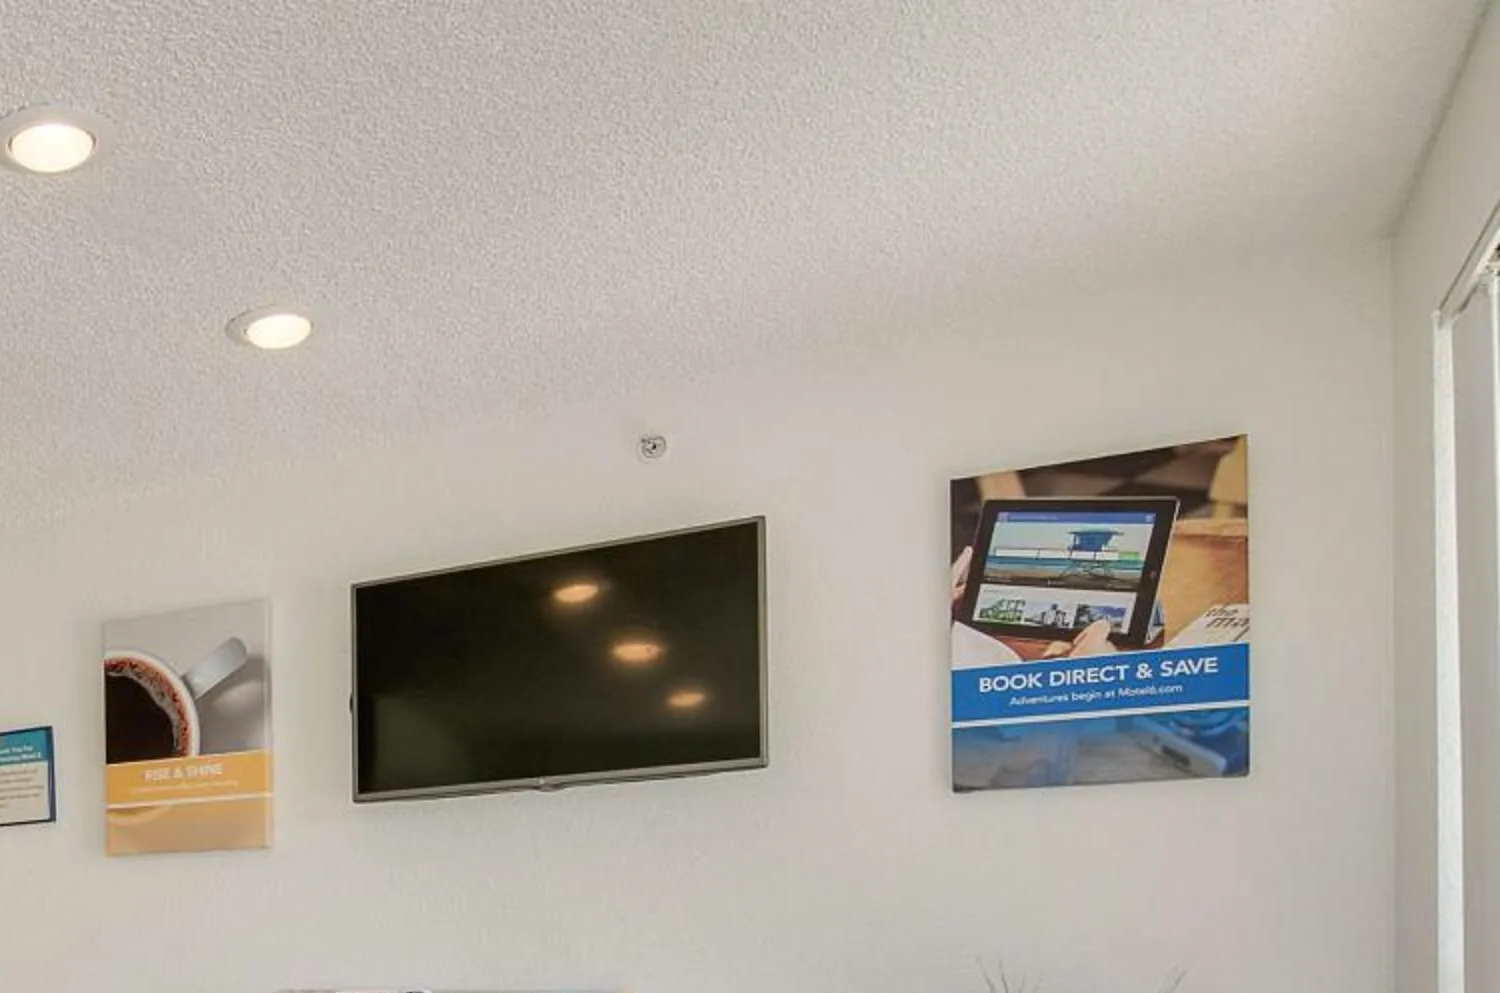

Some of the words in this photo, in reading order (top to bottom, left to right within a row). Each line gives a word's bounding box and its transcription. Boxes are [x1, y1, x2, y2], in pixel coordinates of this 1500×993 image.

[979, 672, 1043, 693] BOOK
[1049, 665, 1130, 687] DIRECT
[1136, 663, 1153, 679] &
[1160, 657, 1219, 677] SAVE
[1009, 694, 1069, 706] Adventures
[1071, 690, 1104, 703] begin
[1104, 688, 1115, 698] at
[1117, 684, 1183, 697] Motel6.com
